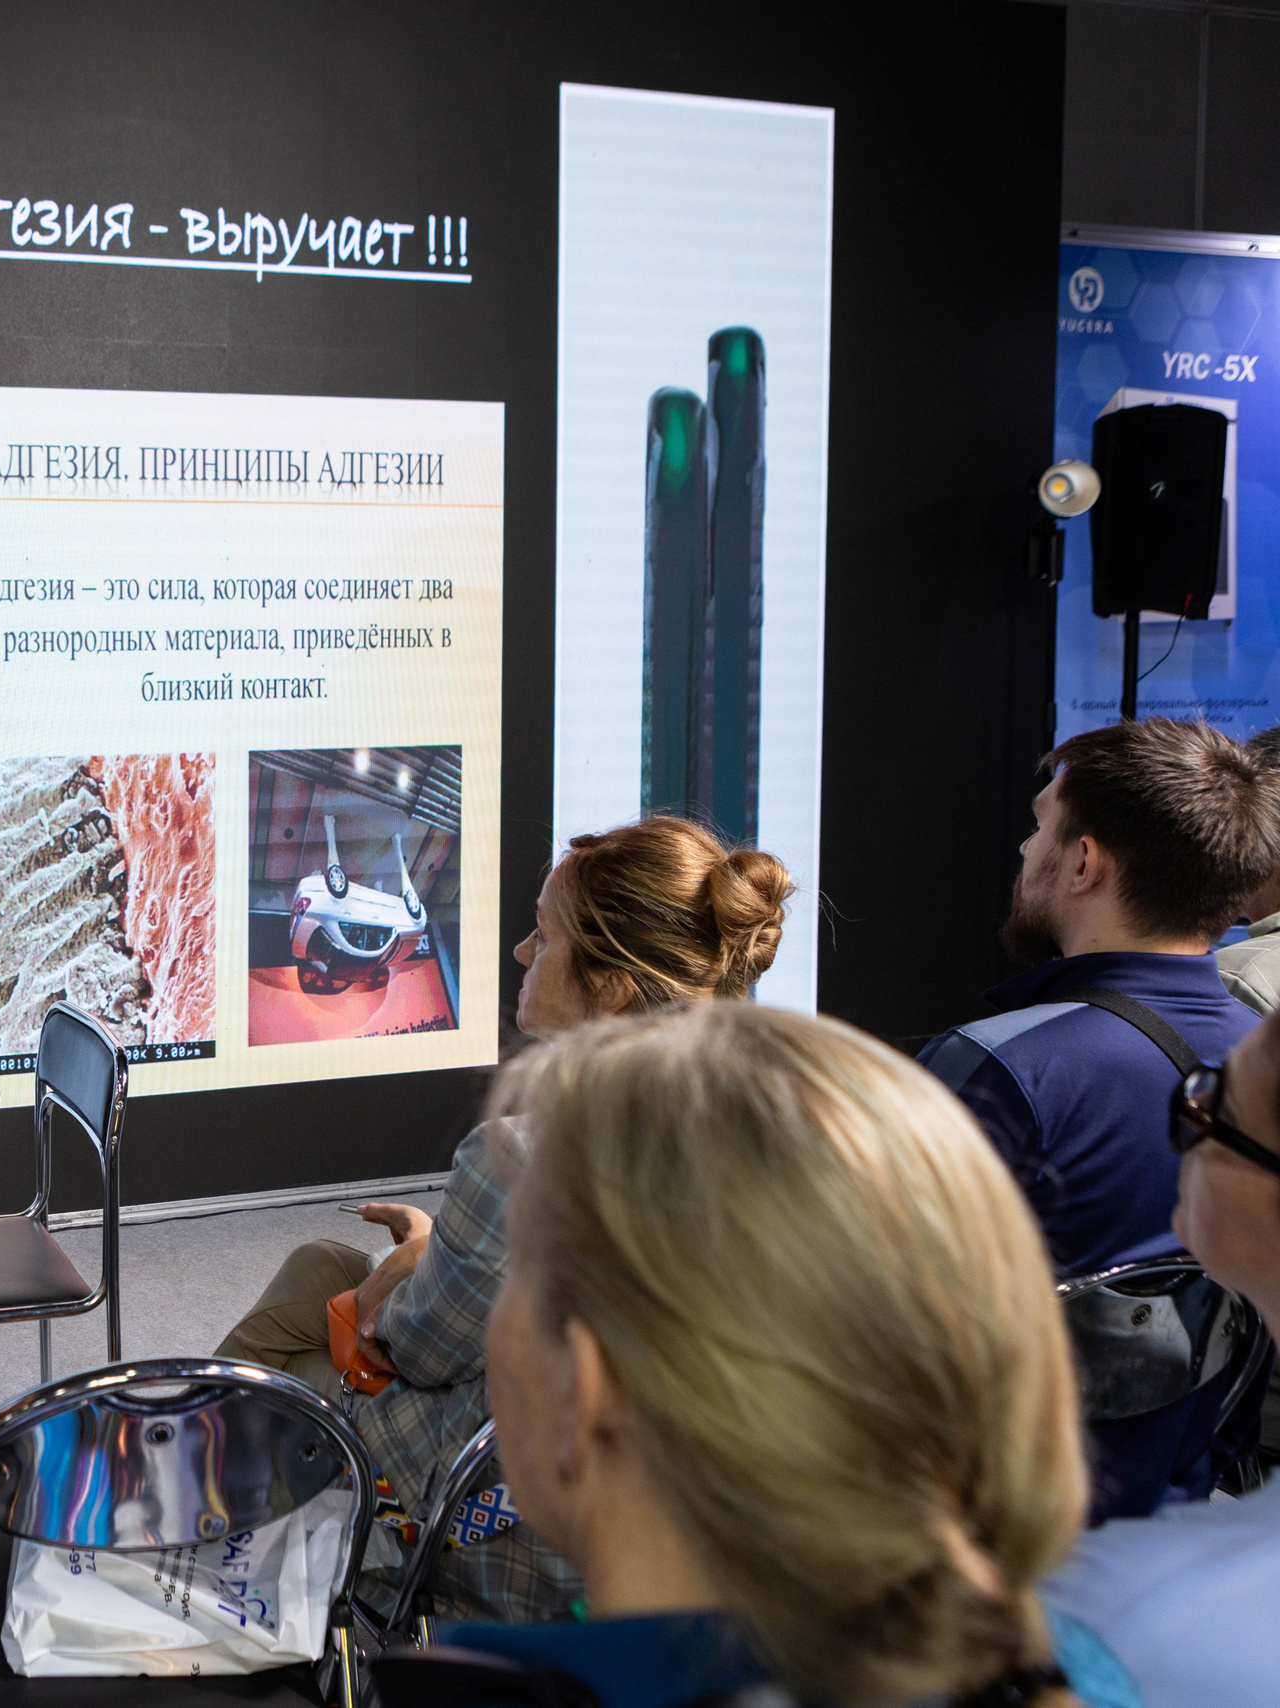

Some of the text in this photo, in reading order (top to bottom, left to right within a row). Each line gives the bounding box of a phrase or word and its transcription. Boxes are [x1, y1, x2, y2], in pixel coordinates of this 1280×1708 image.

[180, 207, 415, 282] выручает
[1059, 317, 1114, 334] YUCERA
[1162, 351, 1211, 380] YRC
[139, 447, 310, 488] ПРИНЦИПЫ
[317, 452, 445, 490] АДГЕЗИИ
[104, 578, 140, 601] это
[148, 578, 205, 604] сила,
[213, 578, 297, 609] которая
[304, 579, 413, 602] соединяет
[419, 579, 454, 604] два
[3, 623, 452, 661] разнородных материала, приведённых в
[141, 671, 328, 702] близкий контакт.
